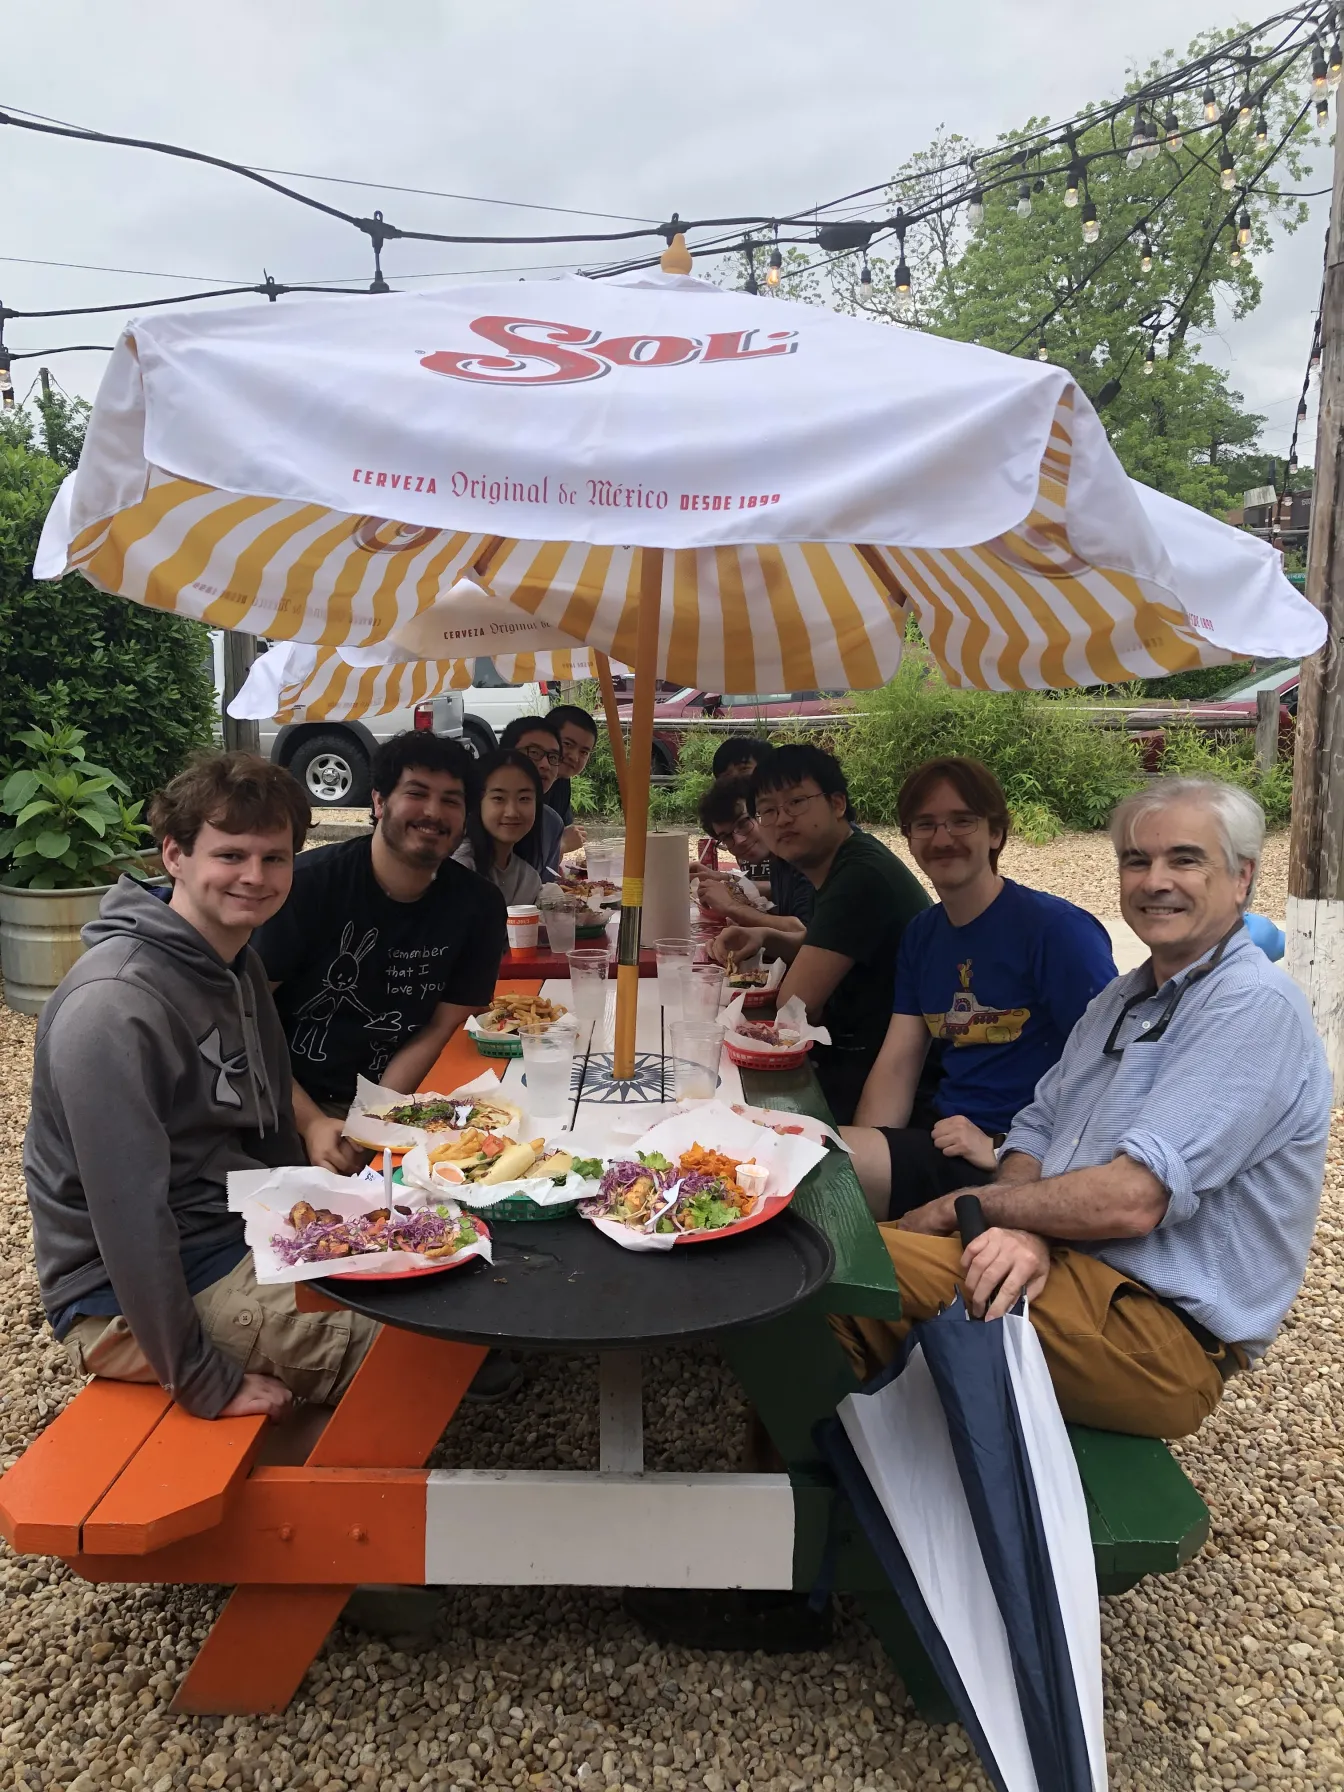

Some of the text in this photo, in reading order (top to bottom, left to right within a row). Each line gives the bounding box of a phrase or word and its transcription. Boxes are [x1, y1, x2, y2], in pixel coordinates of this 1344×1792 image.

[352, 468, 781, 511] CERVEZA Original de México DESDE 1899
[443, 627, 485, 640] CERVEZA
[387, 945, 449, 960] remember
[385, 963, 430, 978] that I
[386, 981, 446, 1000] love you
